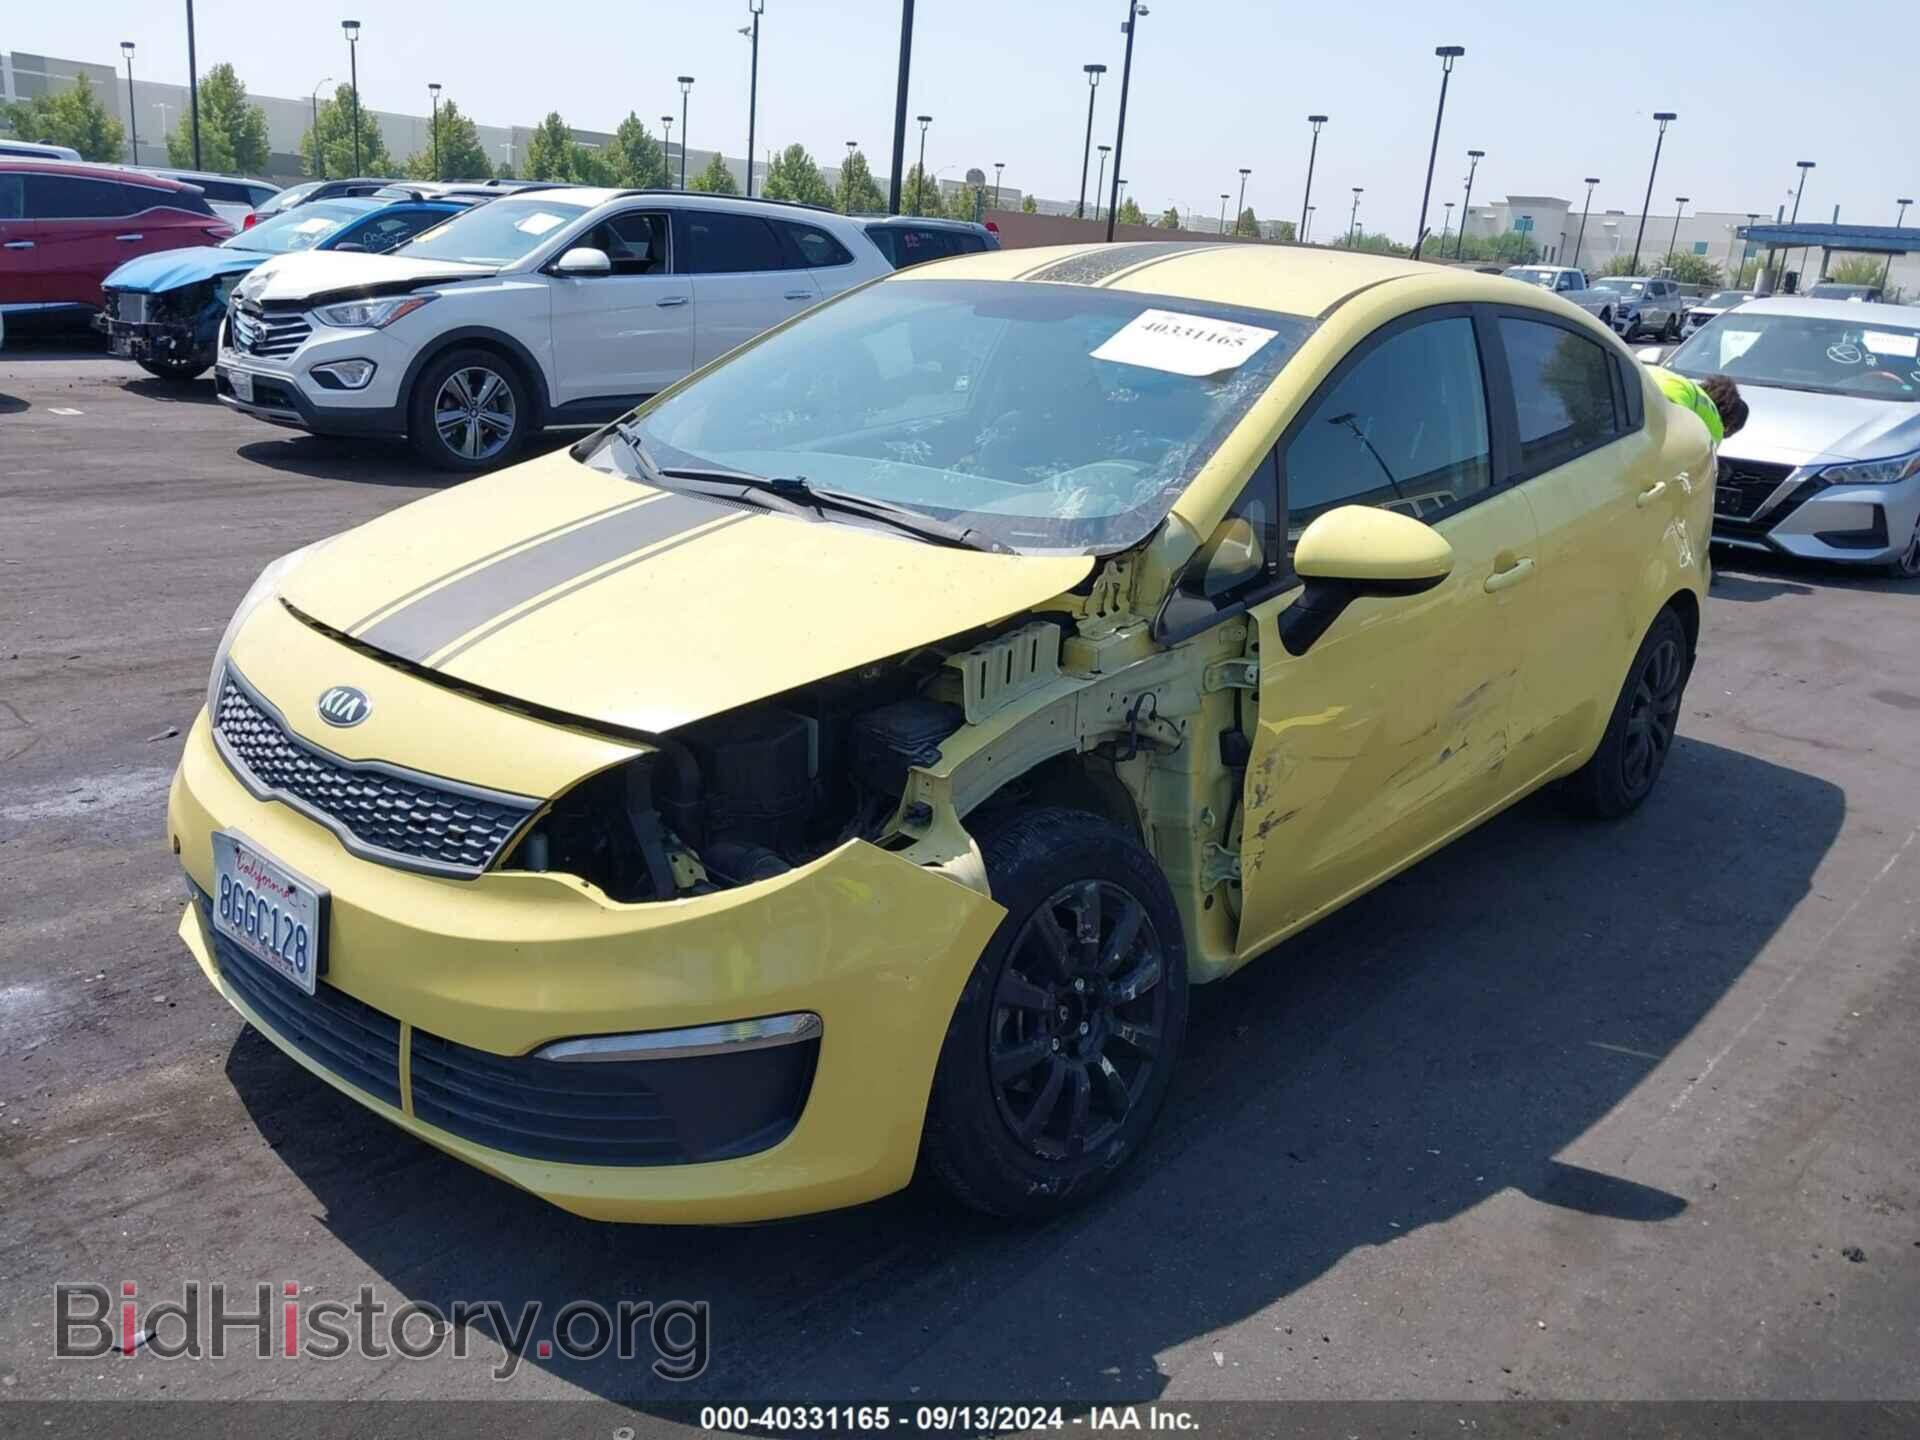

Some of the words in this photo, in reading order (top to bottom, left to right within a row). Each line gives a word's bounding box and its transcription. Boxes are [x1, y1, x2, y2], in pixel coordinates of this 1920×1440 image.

[1141, 321, 1248, 347] 40331165
[320, 688, 361, 721] KIA
[235, 850, 296, 899] California
[219, 873, 308, 974] 8GGC128
